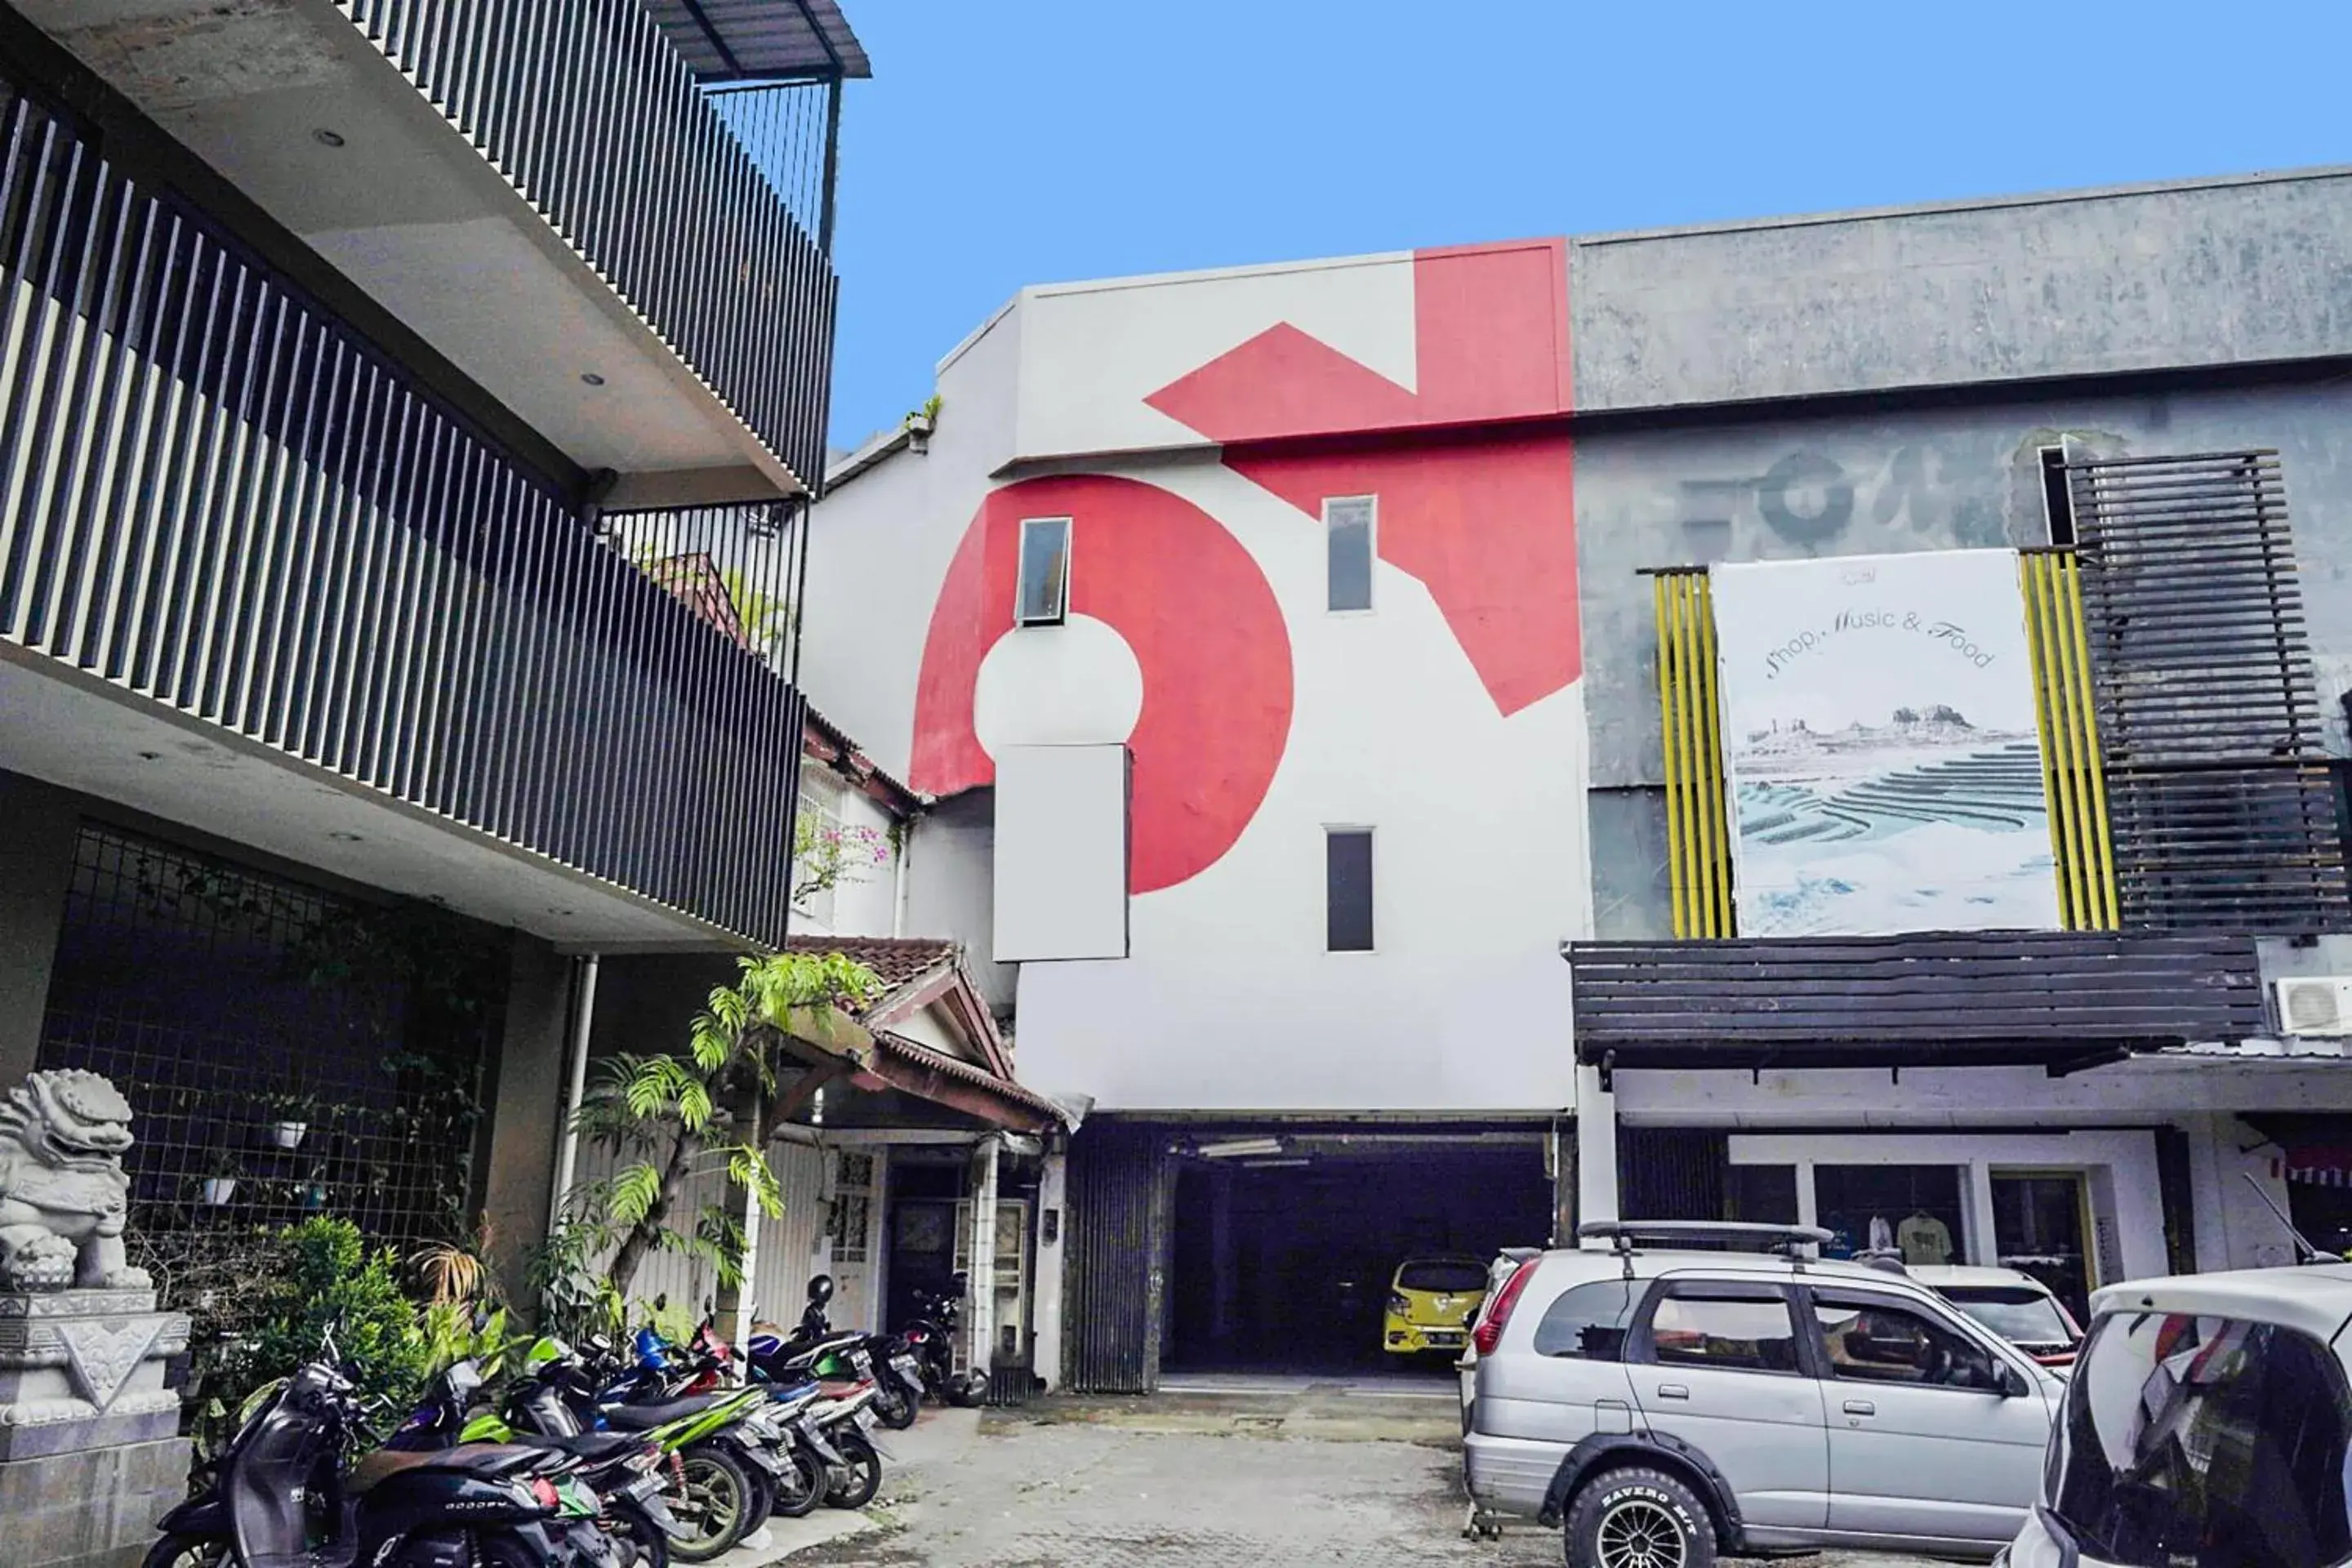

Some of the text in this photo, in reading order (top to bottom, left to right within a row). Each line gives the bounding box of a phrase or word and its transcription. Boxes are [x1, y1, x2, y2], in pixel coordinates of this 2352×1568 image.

[1902, 611, 1922, 631] &
[1927, 621, 1995, 669] Food
[1601, 1486, 1669, 1508] SAVERO
